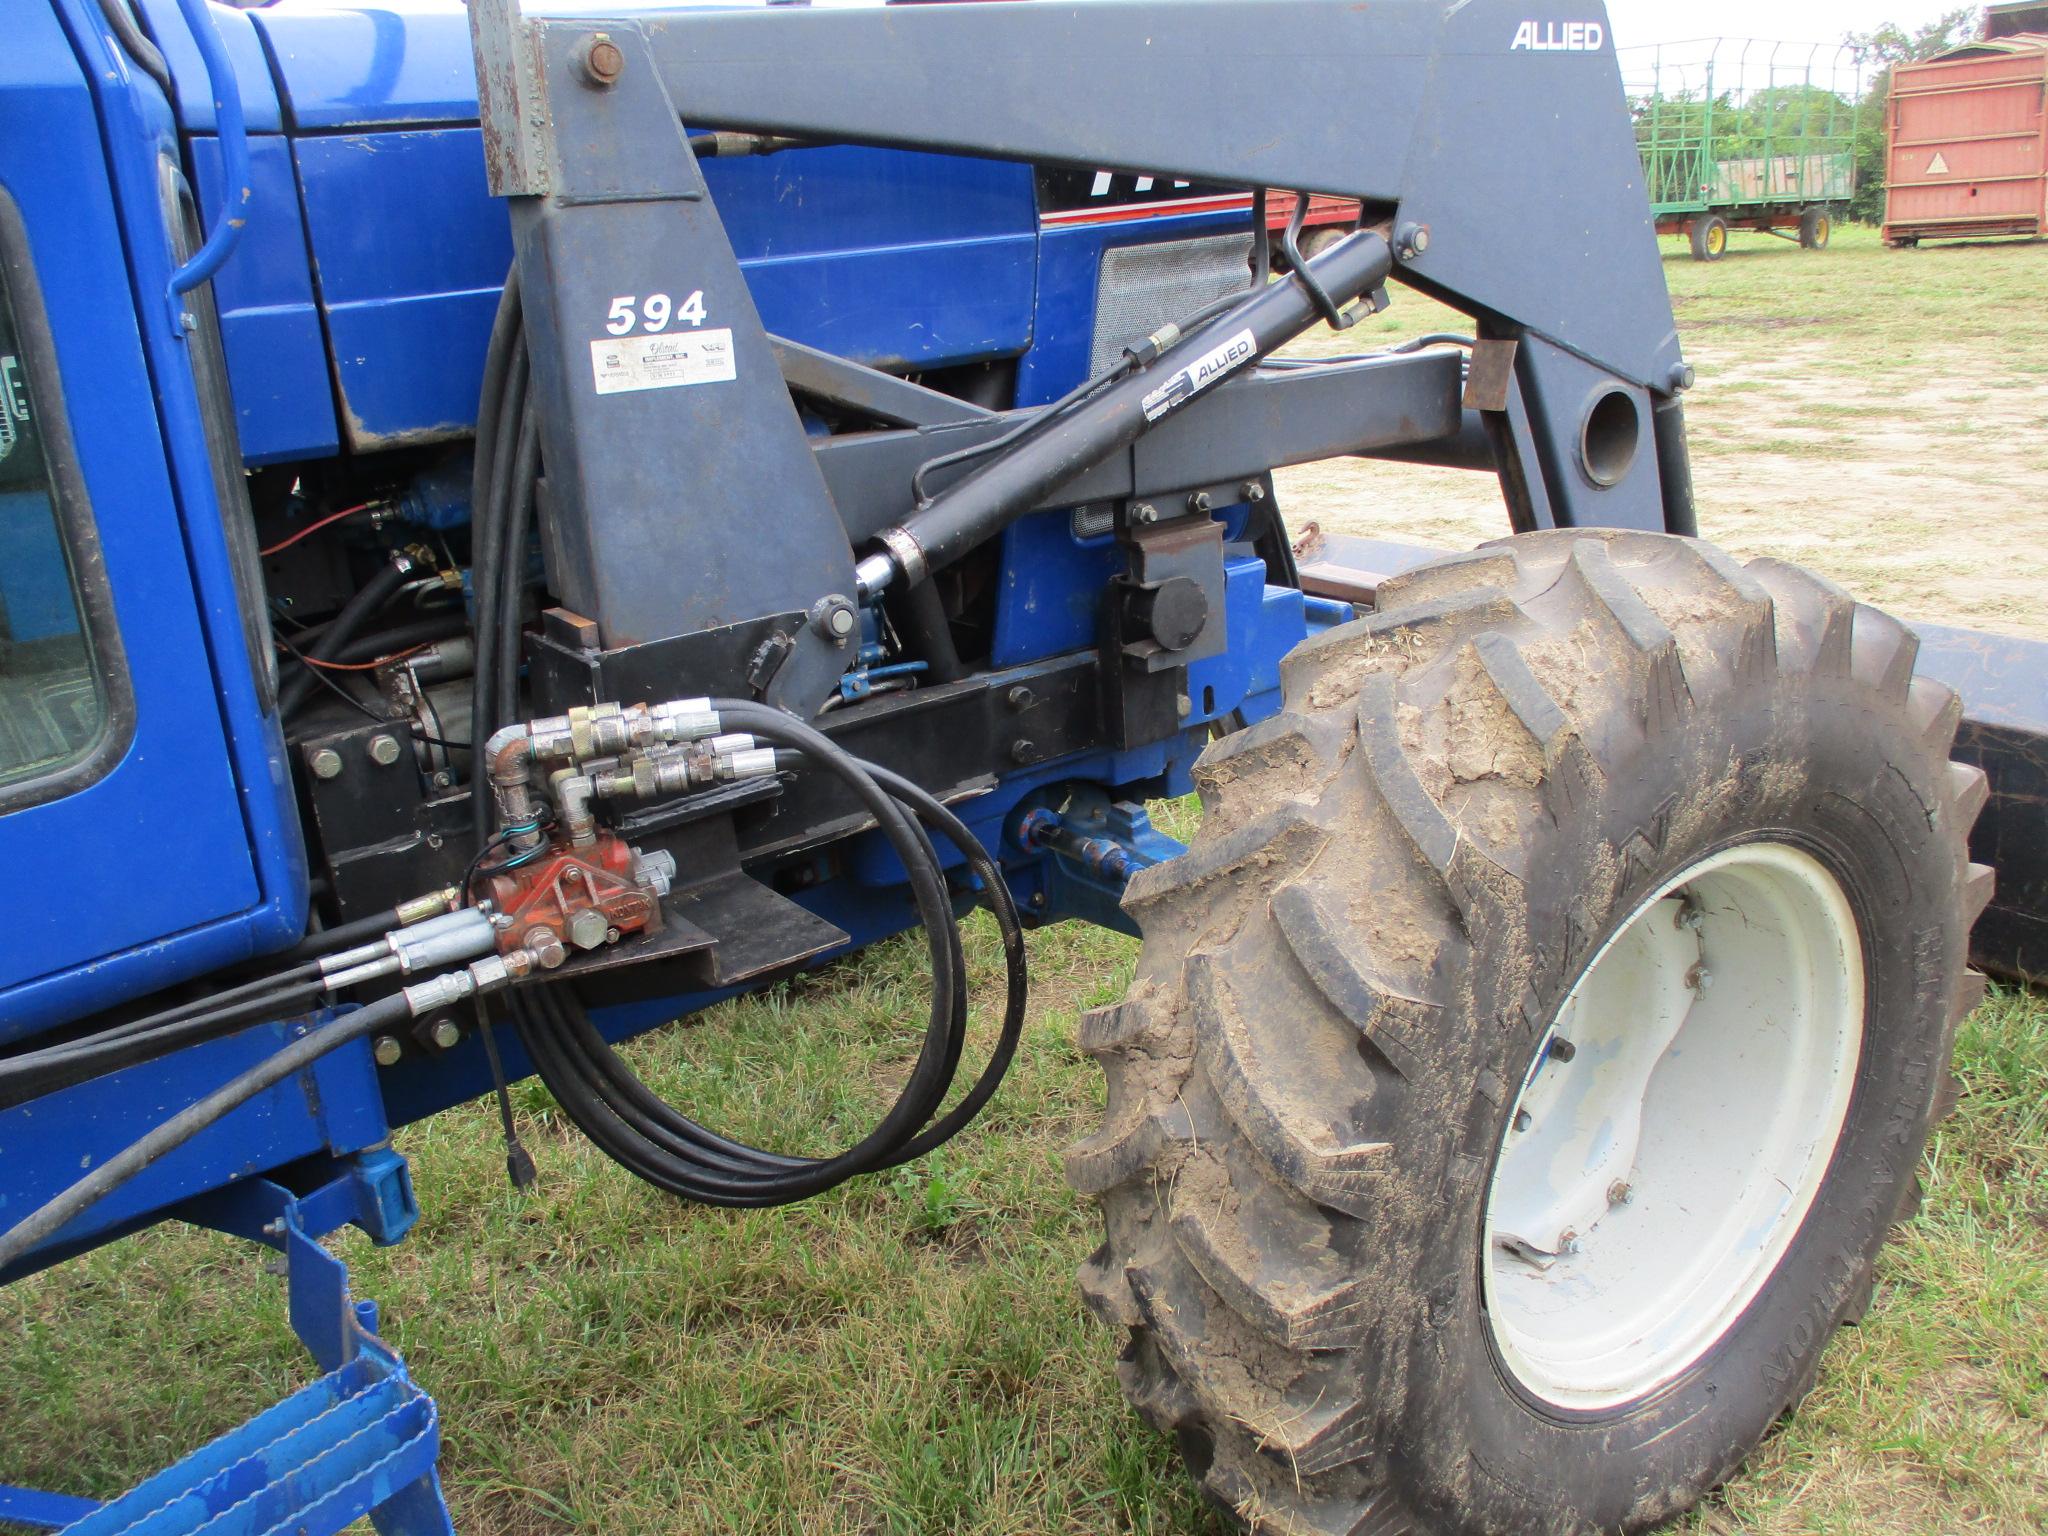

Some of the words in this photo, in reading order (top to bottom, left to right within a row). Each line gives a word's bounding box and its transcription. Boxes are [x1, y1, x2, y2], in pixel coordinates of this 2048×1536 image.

[1509, 21, 1603, 51] ALLIED
[606, 290, 708, 336] 594
[1198, 340, 1249, 382] ALLIED
